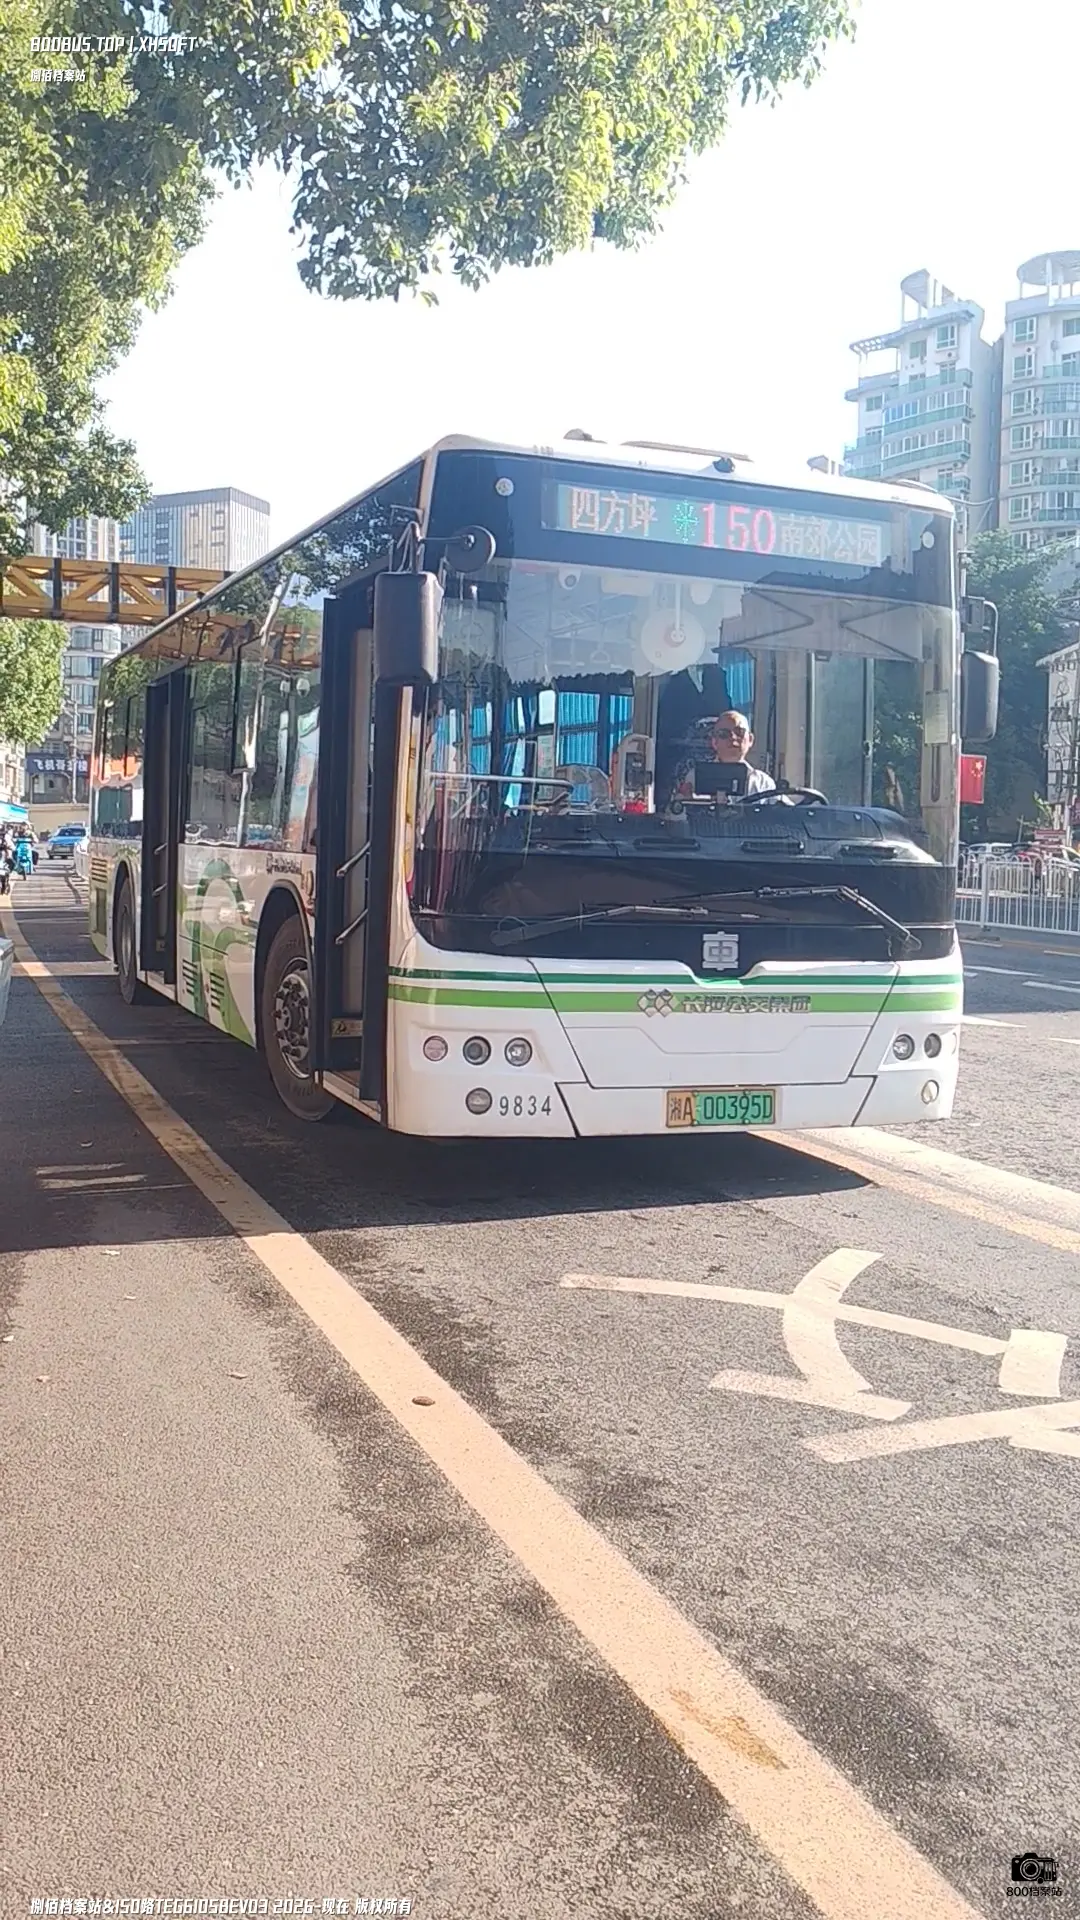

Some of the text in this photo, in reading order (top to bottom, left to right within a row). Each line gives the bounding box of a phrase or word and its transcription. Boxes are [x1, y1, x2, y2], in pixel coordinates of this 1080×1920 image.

[570, 487, 882, 567] 四方坪 150 南郊公园
[499, 1095, 552, 1116] 9834
